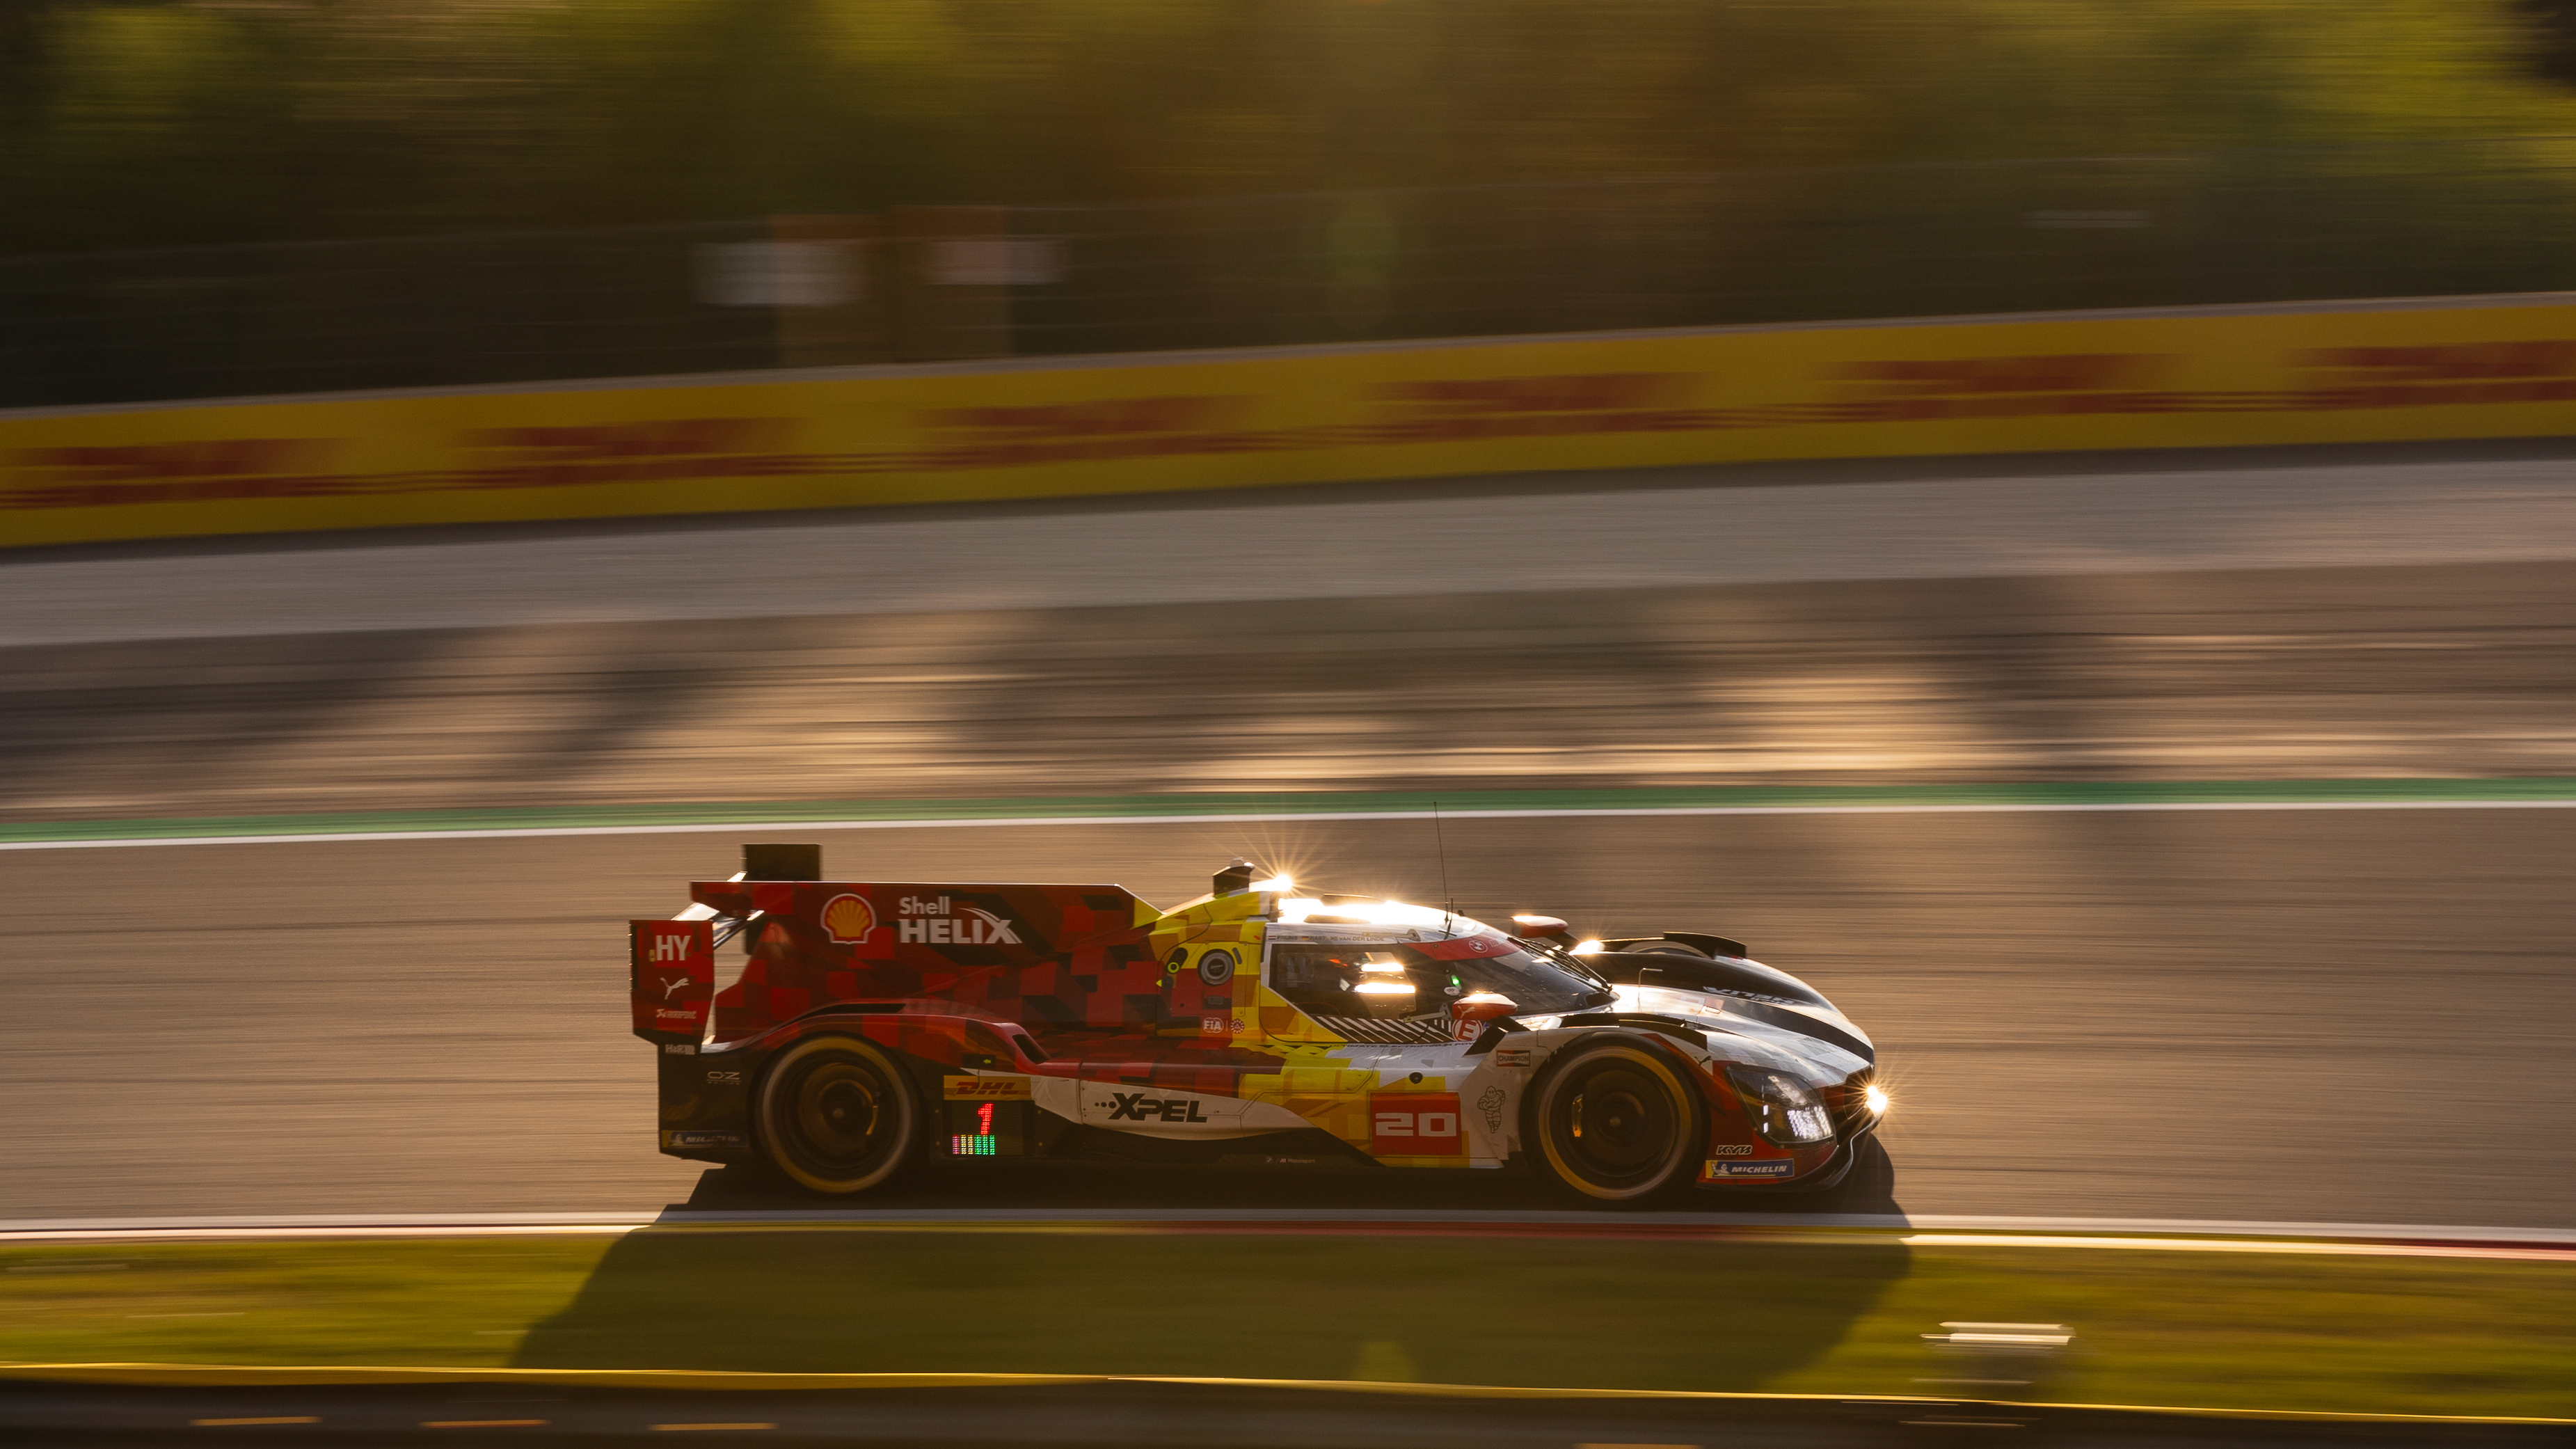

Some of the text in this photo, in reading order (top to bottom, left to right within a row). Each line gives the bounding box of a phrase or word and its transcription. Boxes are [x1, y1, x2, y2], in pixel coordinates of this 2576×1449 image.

[899, 896, 951, 914] Shell
[898, 908, 1023, 944] HELIX
[655, 935, 691, 961] HY
[1457, 1020, 1477, 1041] E
[955, 1082, 1019, 1095] DHL
[978, 1103, 994, 1134] 1
[1107, 1093, 1208, 1123] XPEL
[1376, 1112, 1456, 1137] 20
[1716, 1145, 1753, 1155] KYB
[1731, 1165, 1787, 1173] MICHELIN
